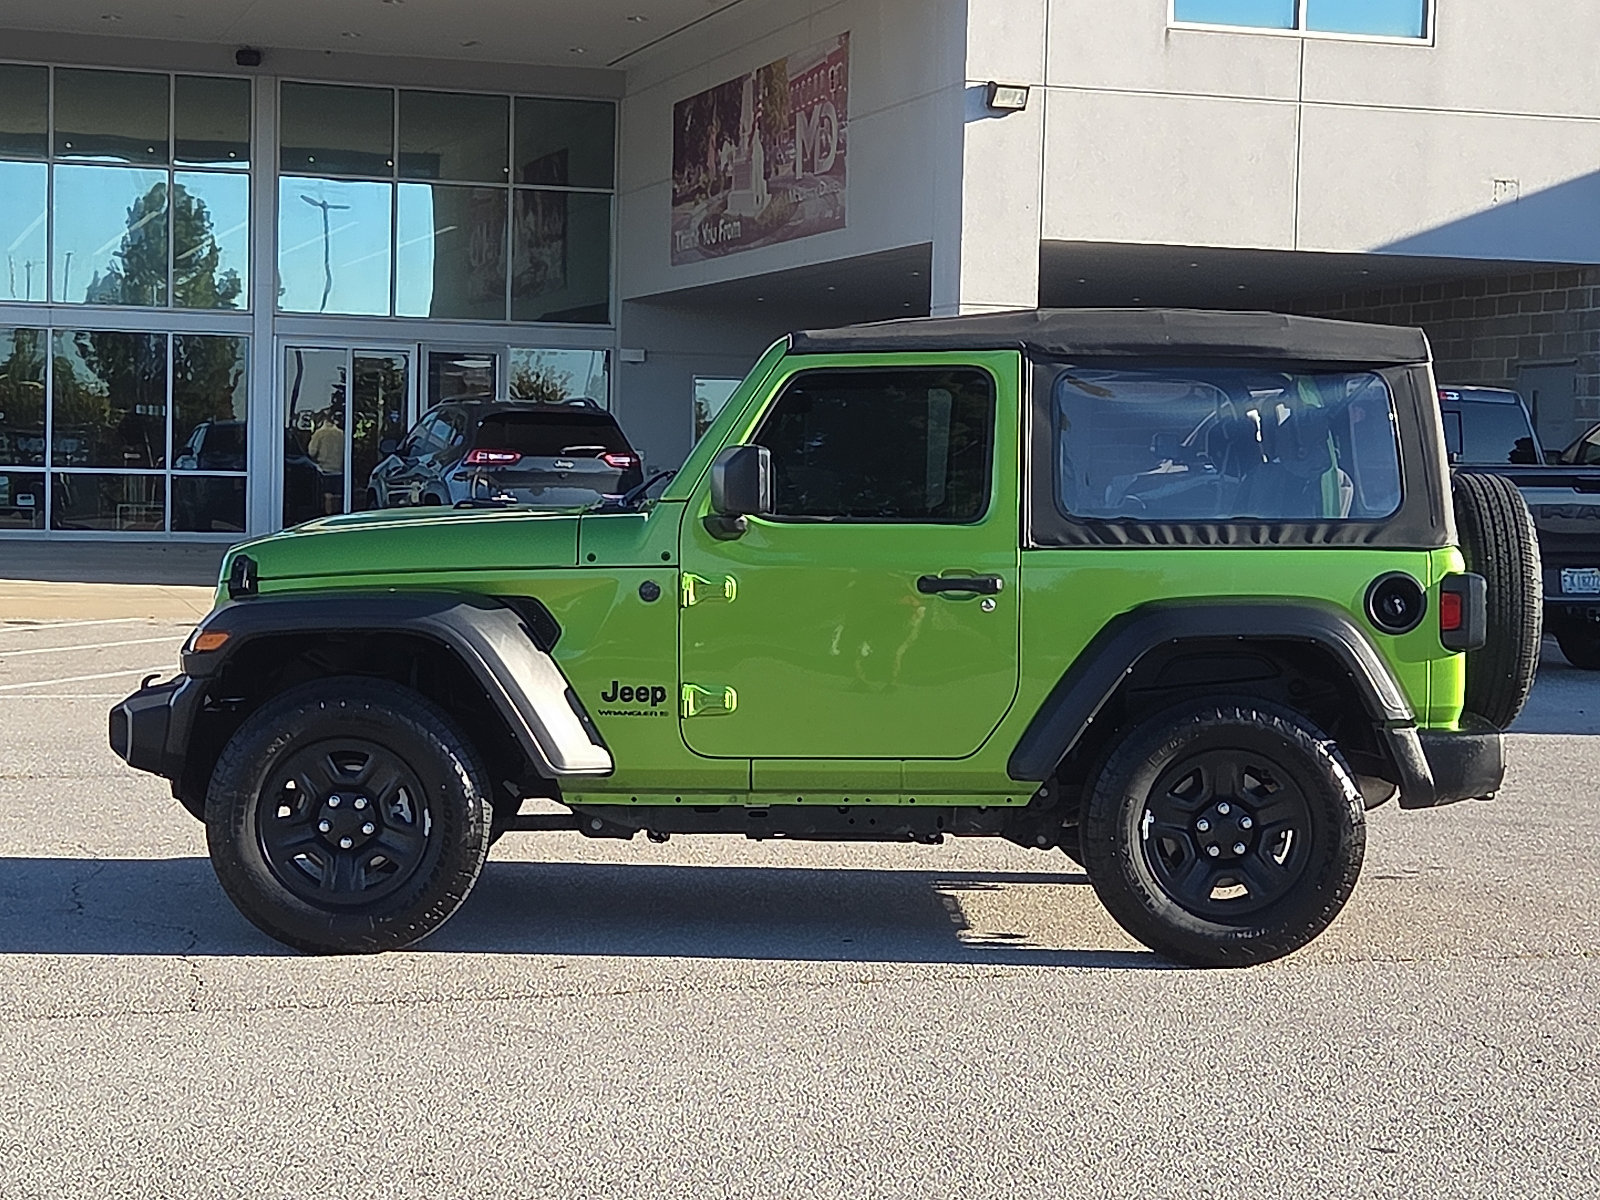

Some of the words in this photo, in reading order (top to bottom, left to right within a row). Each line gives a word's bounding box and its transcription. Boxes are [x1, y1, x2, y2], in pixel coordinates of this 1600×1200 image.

[702, 222, 718, 246] You
[718, 218, 741, 243] From
[601, 680, 667, 707] Jeep
